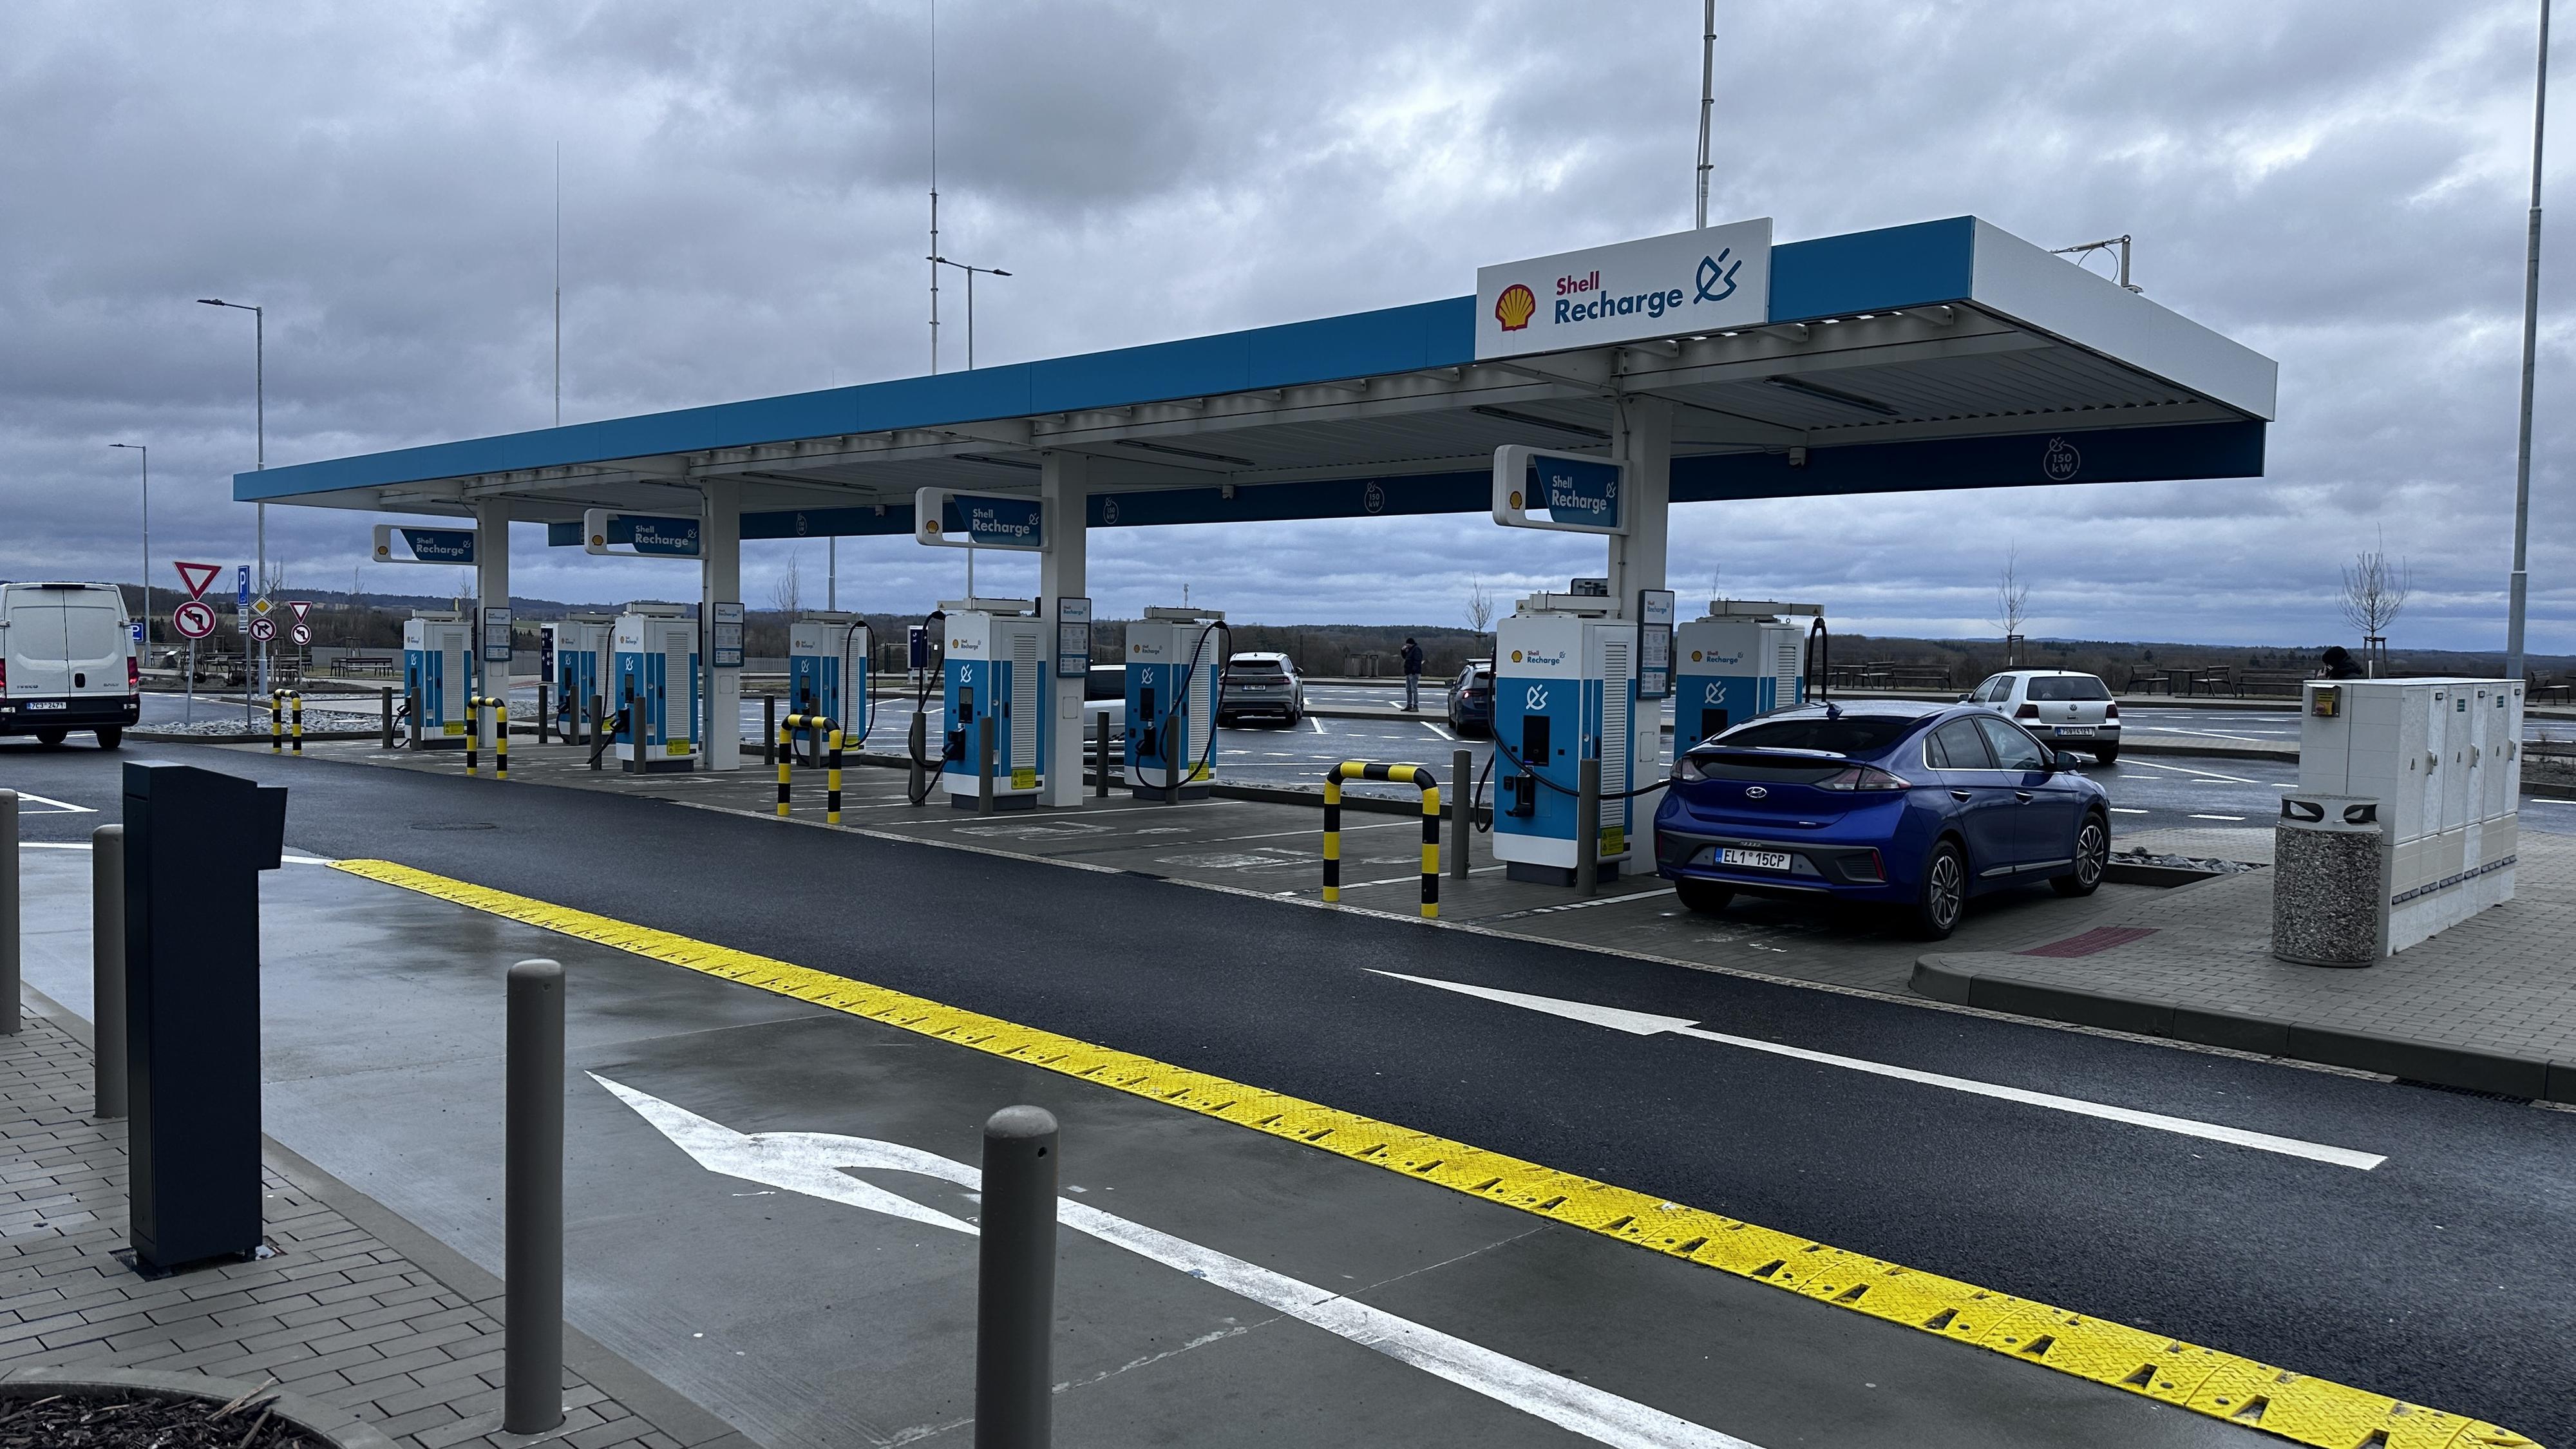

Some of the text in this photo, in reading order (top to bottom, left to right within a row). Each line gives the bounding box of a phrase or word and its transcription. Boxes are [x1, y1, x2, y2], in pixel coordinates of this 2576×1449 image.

[1557, 270, 1599, 296] Shell
[1555, 289, 1683, 324] Recharge
[2052, 453, 2072, 463] 150
[2052, 463, 2073, 473] kW
[1552, 475, 1573, 489] Shell
[1551, 489, 1607, 515] Recharge
[972, 508, 994, 519] Shell
[635, 525, 655, 533] Shell
[972, 518, 1030, 536] Recharge
[636, 533, 688, 547] Recharge
[416, 544, 464, 556] Recharge
[240, 571, 246, 593] P
[132, 625, 140, 637] P
[1527, 656, 1560, 665] Recharge
[1707, 656, 1738, 665] Recharge
[1724, 849, 1785, 867] EL1 15CP
